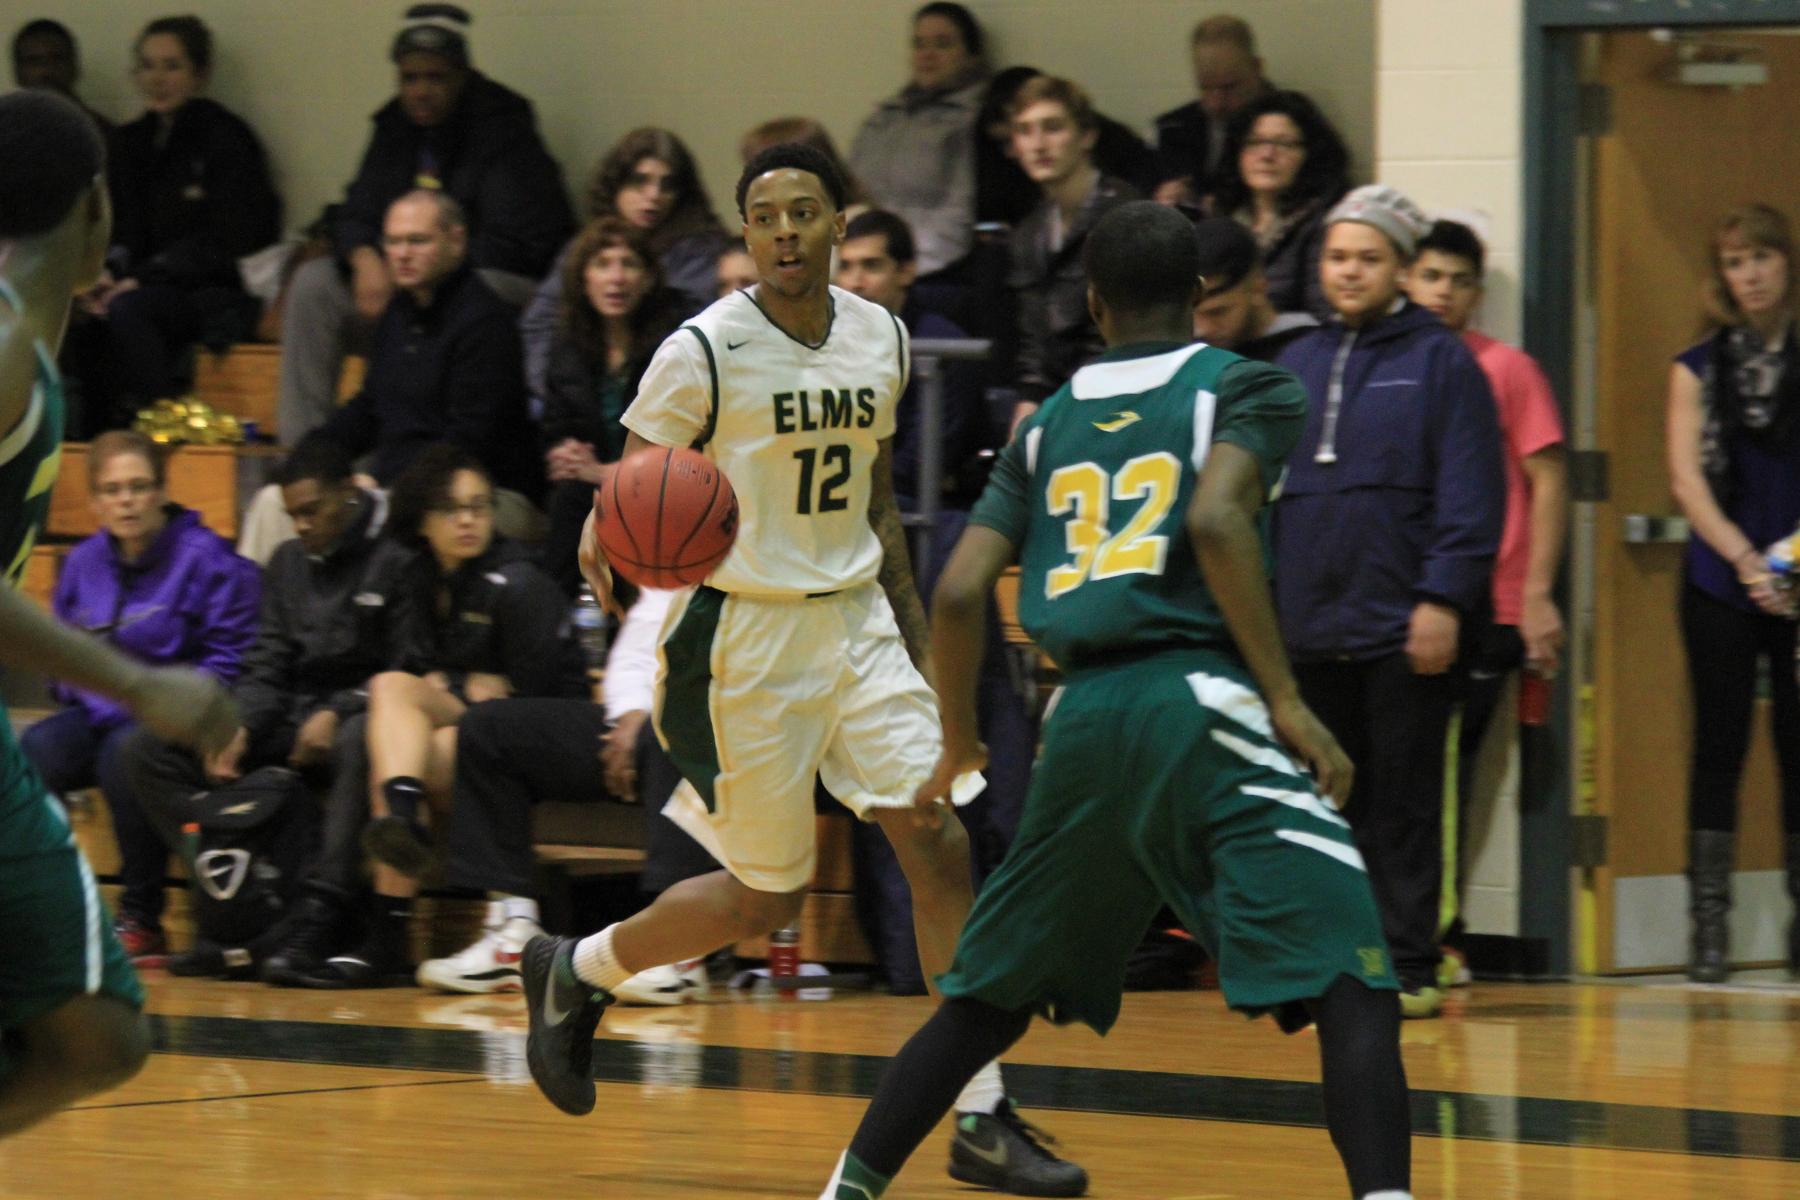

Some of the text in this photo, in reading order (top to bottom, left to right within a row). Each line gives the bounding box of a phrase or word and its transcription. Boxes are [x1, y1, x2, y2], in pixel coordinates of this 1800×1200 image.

[773, 388, 876, 434] ELMS
[793, 444, 851, 515] 12
[1045, 451, 1182, 600] 32
